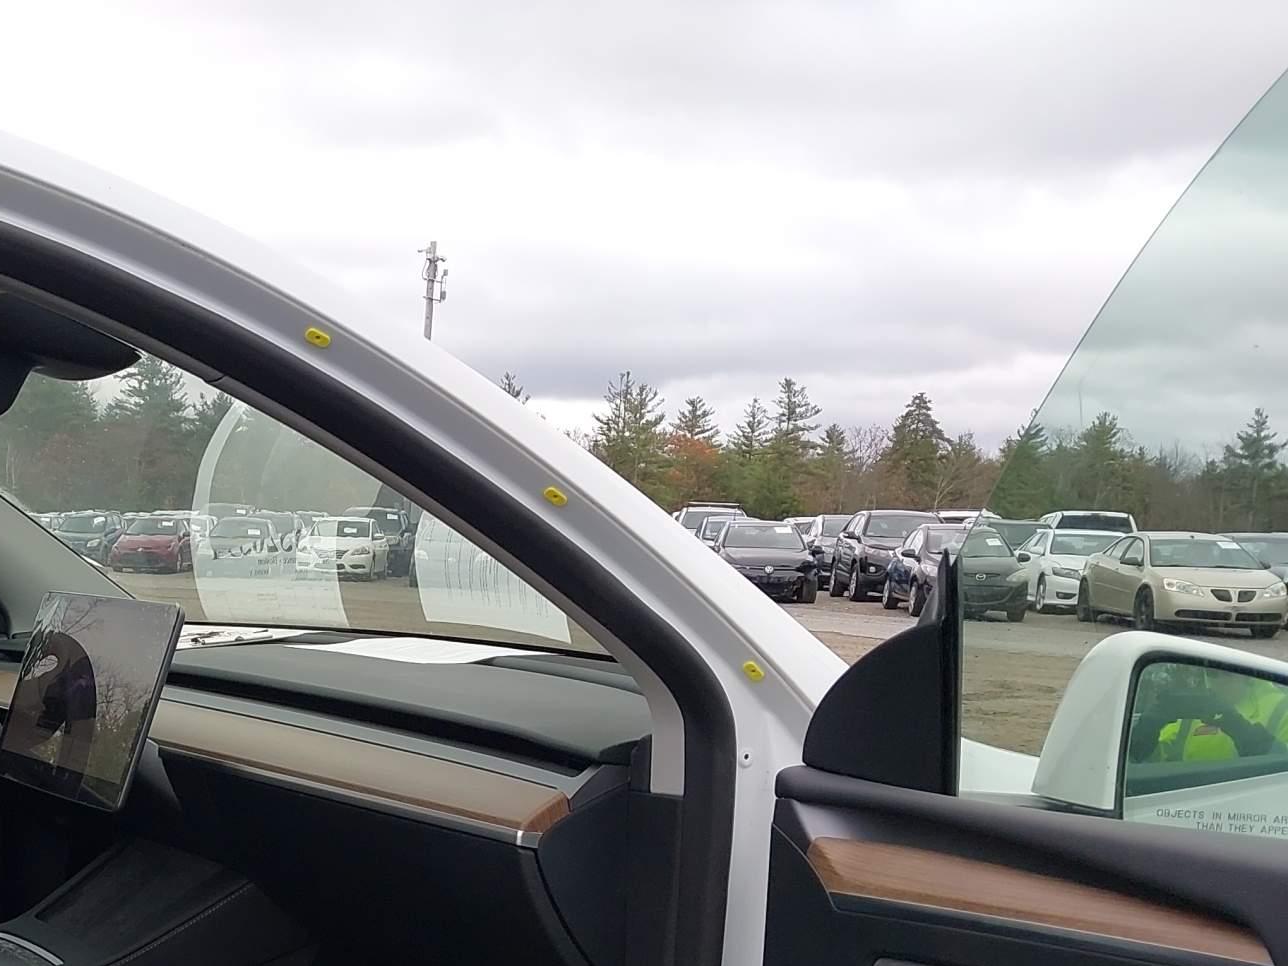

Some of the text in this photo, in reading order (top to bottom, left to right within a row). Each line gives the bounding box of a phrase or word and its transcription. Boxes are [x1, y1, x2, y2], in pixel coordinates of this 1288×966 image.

[1156, 809, 1205, 819] OBJECTS
[1212, 811, 1222, 820] IN
[1227, 812, 1267, 822] MIRROR
[1196, 822, 1223, 832] THAN
[1229, 824, 1255, 833] THEY
